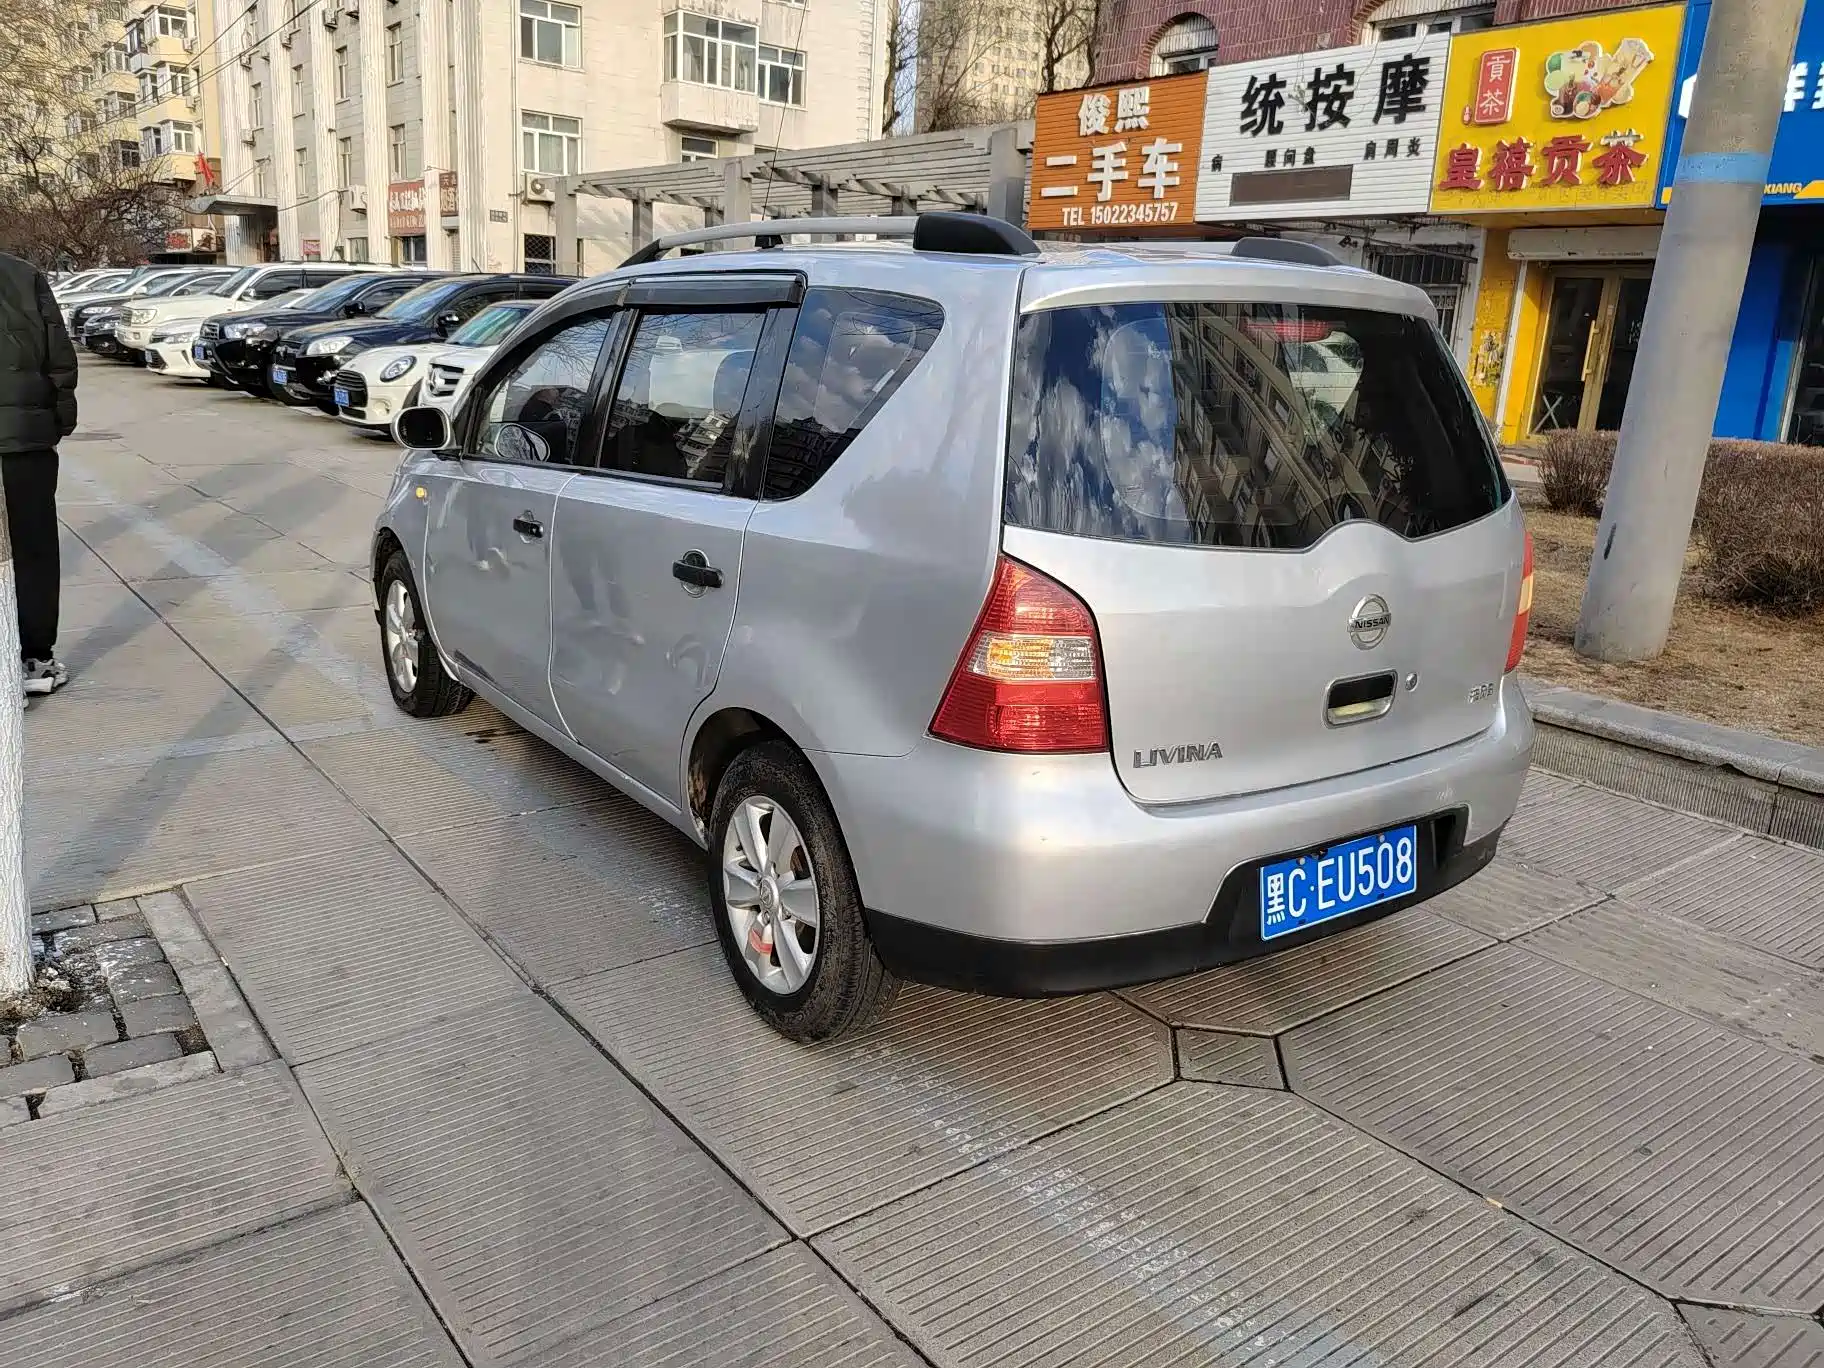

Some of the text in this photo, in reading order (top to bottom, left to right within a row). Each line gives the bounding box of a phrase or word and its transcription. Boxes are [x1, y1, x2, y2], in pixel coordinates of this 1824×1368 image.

[1240, 53, 1430, 137] 统按摩
[1363, 136, 1421, 161] 肩周炎
[1041, 137, 1183, 202] 二手车
[1062, 202, 1178, 226] TEL 15022345757
[1354, 616, 1390, 629] NISSAN
[1133, 742, 1223, 769] LIVINA
